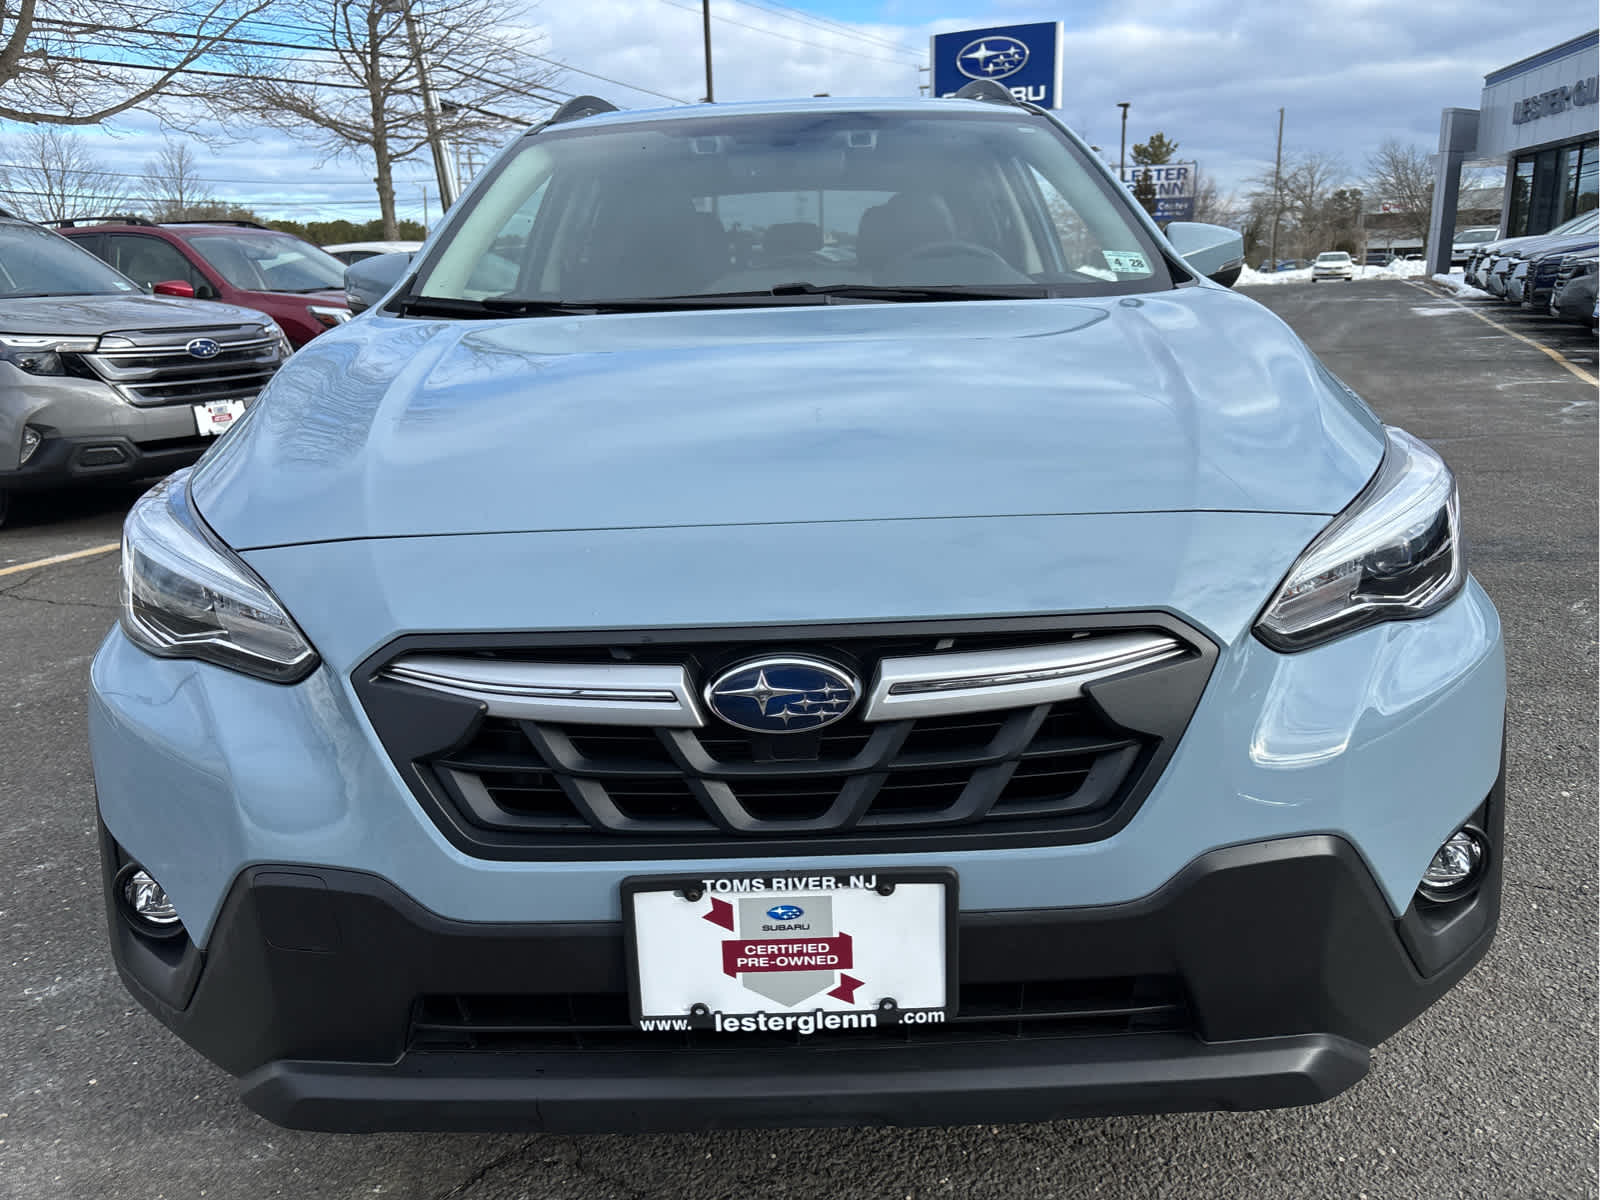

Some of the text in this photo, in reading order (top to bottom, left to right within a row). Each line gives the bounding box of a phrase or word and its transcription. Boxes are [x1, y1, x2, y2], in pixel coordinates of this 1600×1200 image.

[1129, 258, 1144, 268] 28
[702, 879, 765, 893] TOMS
[851, 875, 877, 889] NJ
[762, 924, 810, 932] SUBARU
[744, 943, 830, 955] CERTIFIED
[737, 955, 839, 967] PRE-OWNED
[640, 1009, 945, 1035] www. lesterglenn .com
